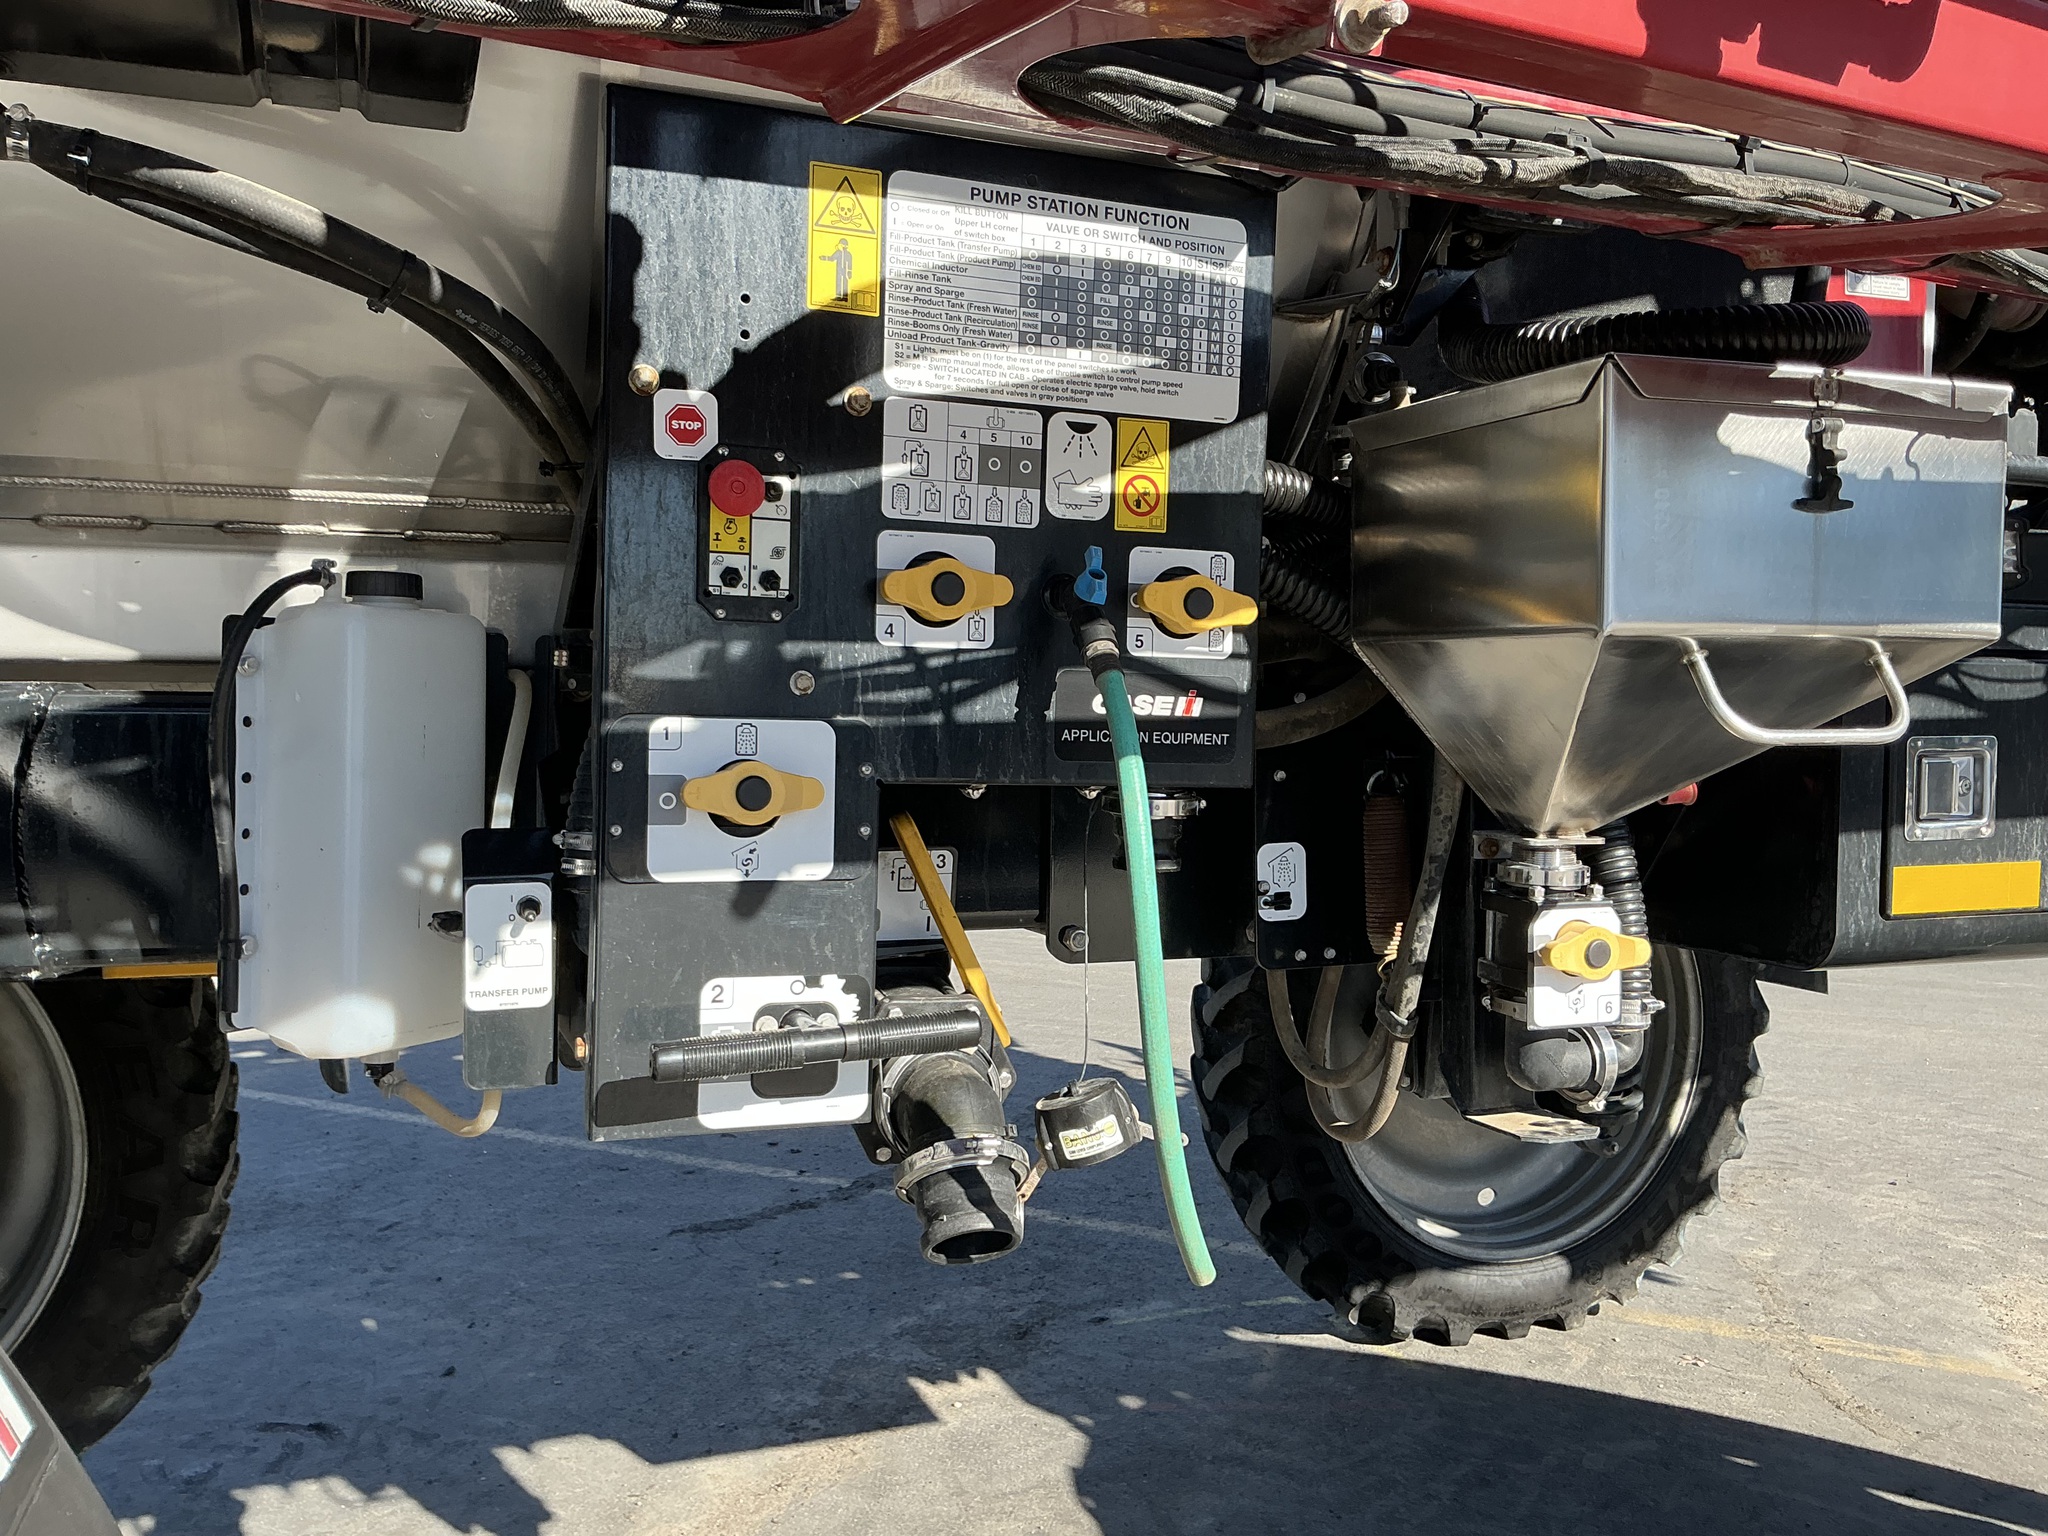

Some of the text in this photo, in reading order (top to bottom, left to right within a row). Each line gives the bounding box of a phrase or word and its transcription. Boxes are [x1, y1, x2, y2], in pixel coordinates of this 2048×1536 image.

[907, 205, 929, 214] Closed
[954, 206, 1008, 220] KILL BUTTON
[970, 186, 1189, 230] PUMP STATION FUNCTION
[906, 221, 924, 230] Open
[954, 217, 978, 228] Upper
[993, 224, 1018, 233] corner
[889, 231, 1017, 257] Fill-Product Tank (Transfer Pump)
[964, 229, 989, 240] switch
[991, 233, 1005, 242] box
[1046, 221, 1225, 255] VALVE OR SWITCH AND POSITION
[889, 244, 1016, 270] Fill-Product Tank (Product Pump)
[1030, 237, 1224, 271] 1 2 3 5 6 7 9 10 S1 S2
[889, 255, 968, 274] Chemical Inductor
[888, 268, 929, 281] Fill-Rinse
[931, 273, 952, 283] Tank
[888, 280, 965, 298] Spray and Sparge
[888, 292, 944, 307] Rinse-Product
[946, 299, 965, 309] Tank
[966, 302, 990, 313] (Fresh
[992, 305, 1017, 317] Water)
[887, 305, 942, 320] Rinse-Product
[944, 312, 962, 322] Tank
[964, 314, 1017, 330] (Recirculation)
[887, 316, 940, 331] Rinse-Booms
[942, 323, 960, 334] Only
[961, 325, 986, 337] (Fresh
[988, 328, 1012, 340] Water)
[887, 329, 918, 340] Unload
[920, 333, 954, 344] Product
[956, 337, 1010, 352] Tank-Gravity
[912, 344, 938, 355] Lights,
[983, 352, 991, 360] (1)
[1057, 360, 1076, 370] panel
[1078, 362, 1108, 372] switches
[1119, 367, 1137, 375] work
[893, 359, 920, 370] Sparge
[928, 363, 958, 373] SWITCH
[961, 366, 996, 377] LOCATED
[1008, 372, 1024, 380] CAB
[1031, 374, 1064, 385] Operates
[1065, 378, 1092, 387] electric
[1093, 382, 1117, 392] sparge
[1119, 384, 1139, 393] valve,
[1140, 386, 1155, 394] hold
[1157, 388, 1178, 396] switch
[894, 350, 904, 358] S2
[930, 356, 951, 365] pump
[953, 357, 979, 367] manual
[982, 360, 1005, 371] mode,
[1007, 363, 1029, 372] allows
[1055, 368, 1080, 377] throttle
[1082, 371, 1105, 380] switch
[1115, 374, 1140, 384] control
[1141, 379, 1161, 387] pump
[1162, 380, 1183, 390] speed
[893, 377, 915, 387] Spray
[924, 380, 953, 391] Sparge:
[955, 383, 988, 393] Switches
[1005, 389, 1028, 397] valves
[1038, 393, 1054, 402] gray
[1055, 394, 1088, 405] positions
[953, 375, 984, 385] seconds
[1010, 383, 1029, 391] open
[1040, 384, 1059, 393] close
[1070, 389, 1094, 398] sparge
[1096, 390, 1114, 398] valve
[671, 420, 702, 430] STOP
[960, 430, 1032, 446] 4 5 10
[884, 623, 895, 638] 4
[1134, 634, 1144, 648] 5
[1092, 694, 1174, 716] CSE
[662, 726, 670, 740] 1
[1062, 730, 1230, 746] APPLICN EQUIPMENT
[936, 854, 946, 868] 3
[469, 986, 548, 998] TRANSFER PUMP
[710, 984, 724, 1004] 2
[1606, 1001, 1613, 1014] 6
